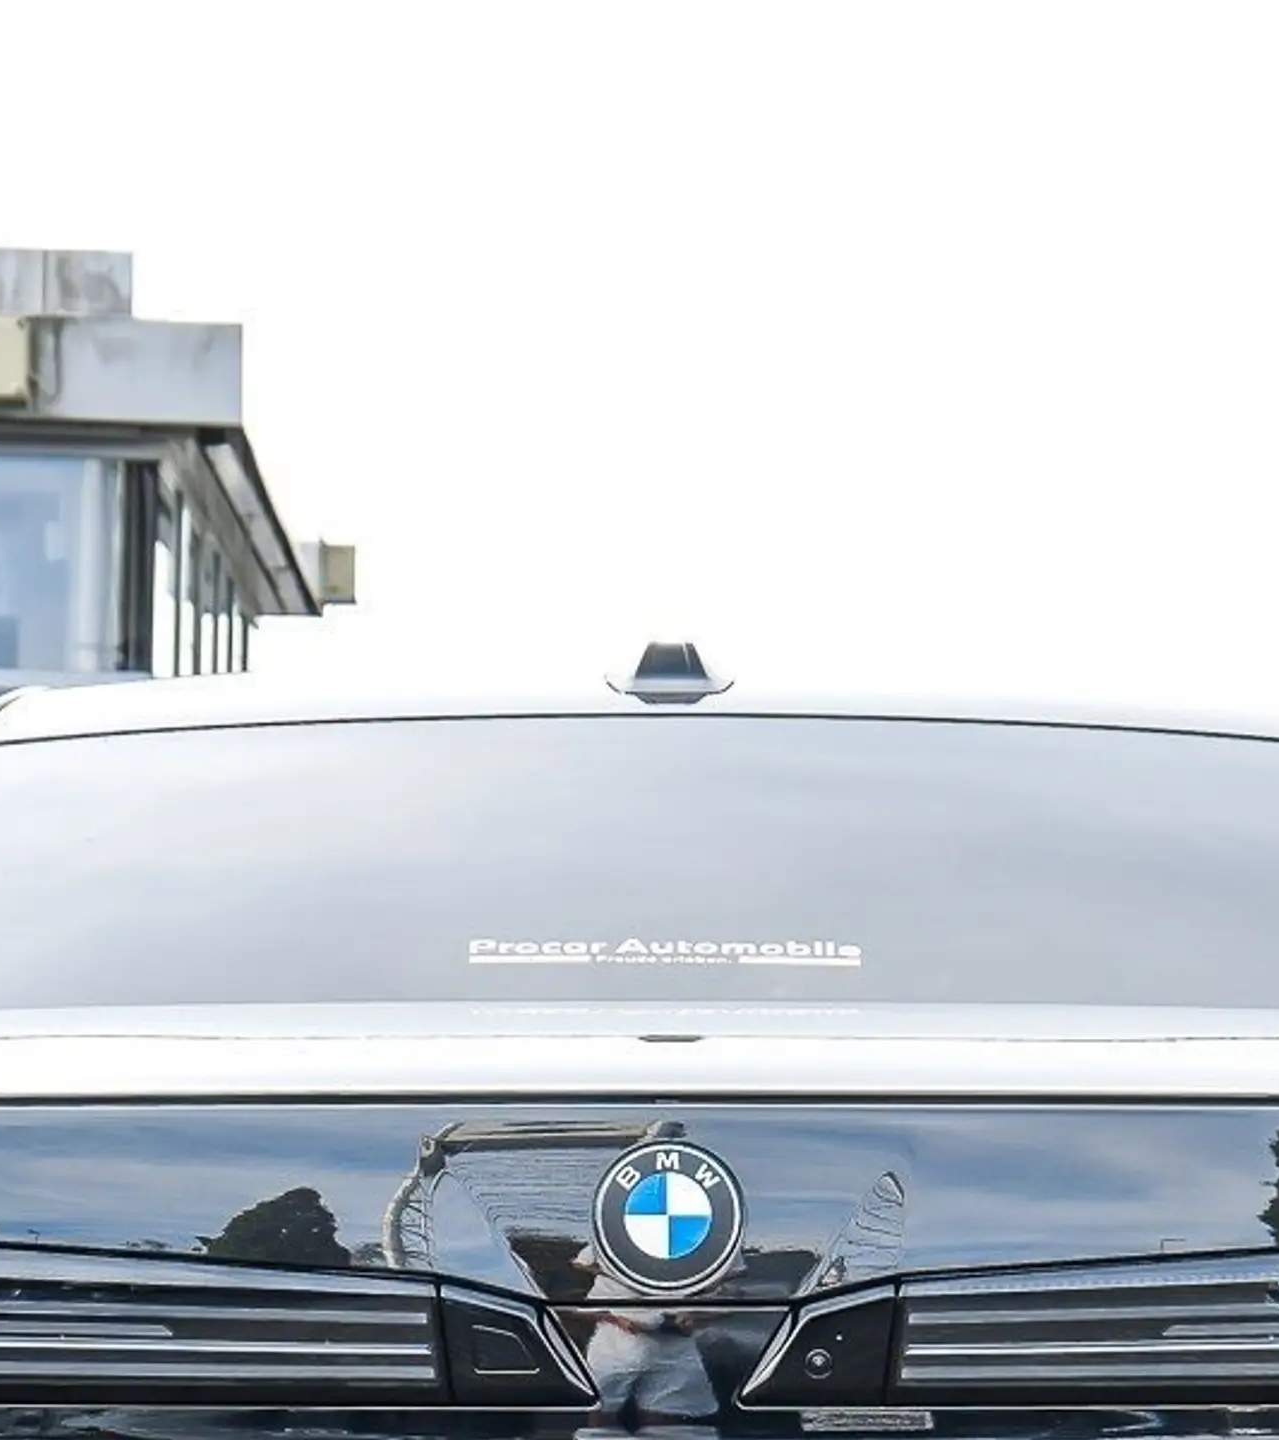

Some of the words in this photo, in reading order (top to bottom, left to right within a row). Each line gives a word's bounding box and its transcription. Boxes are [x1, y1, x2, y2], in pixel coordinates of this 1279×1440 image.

[468, 938, 608, 955] Procar
[614, 937, 862, 957] Automobile
[615, 1151, 721, 1191] BMW
